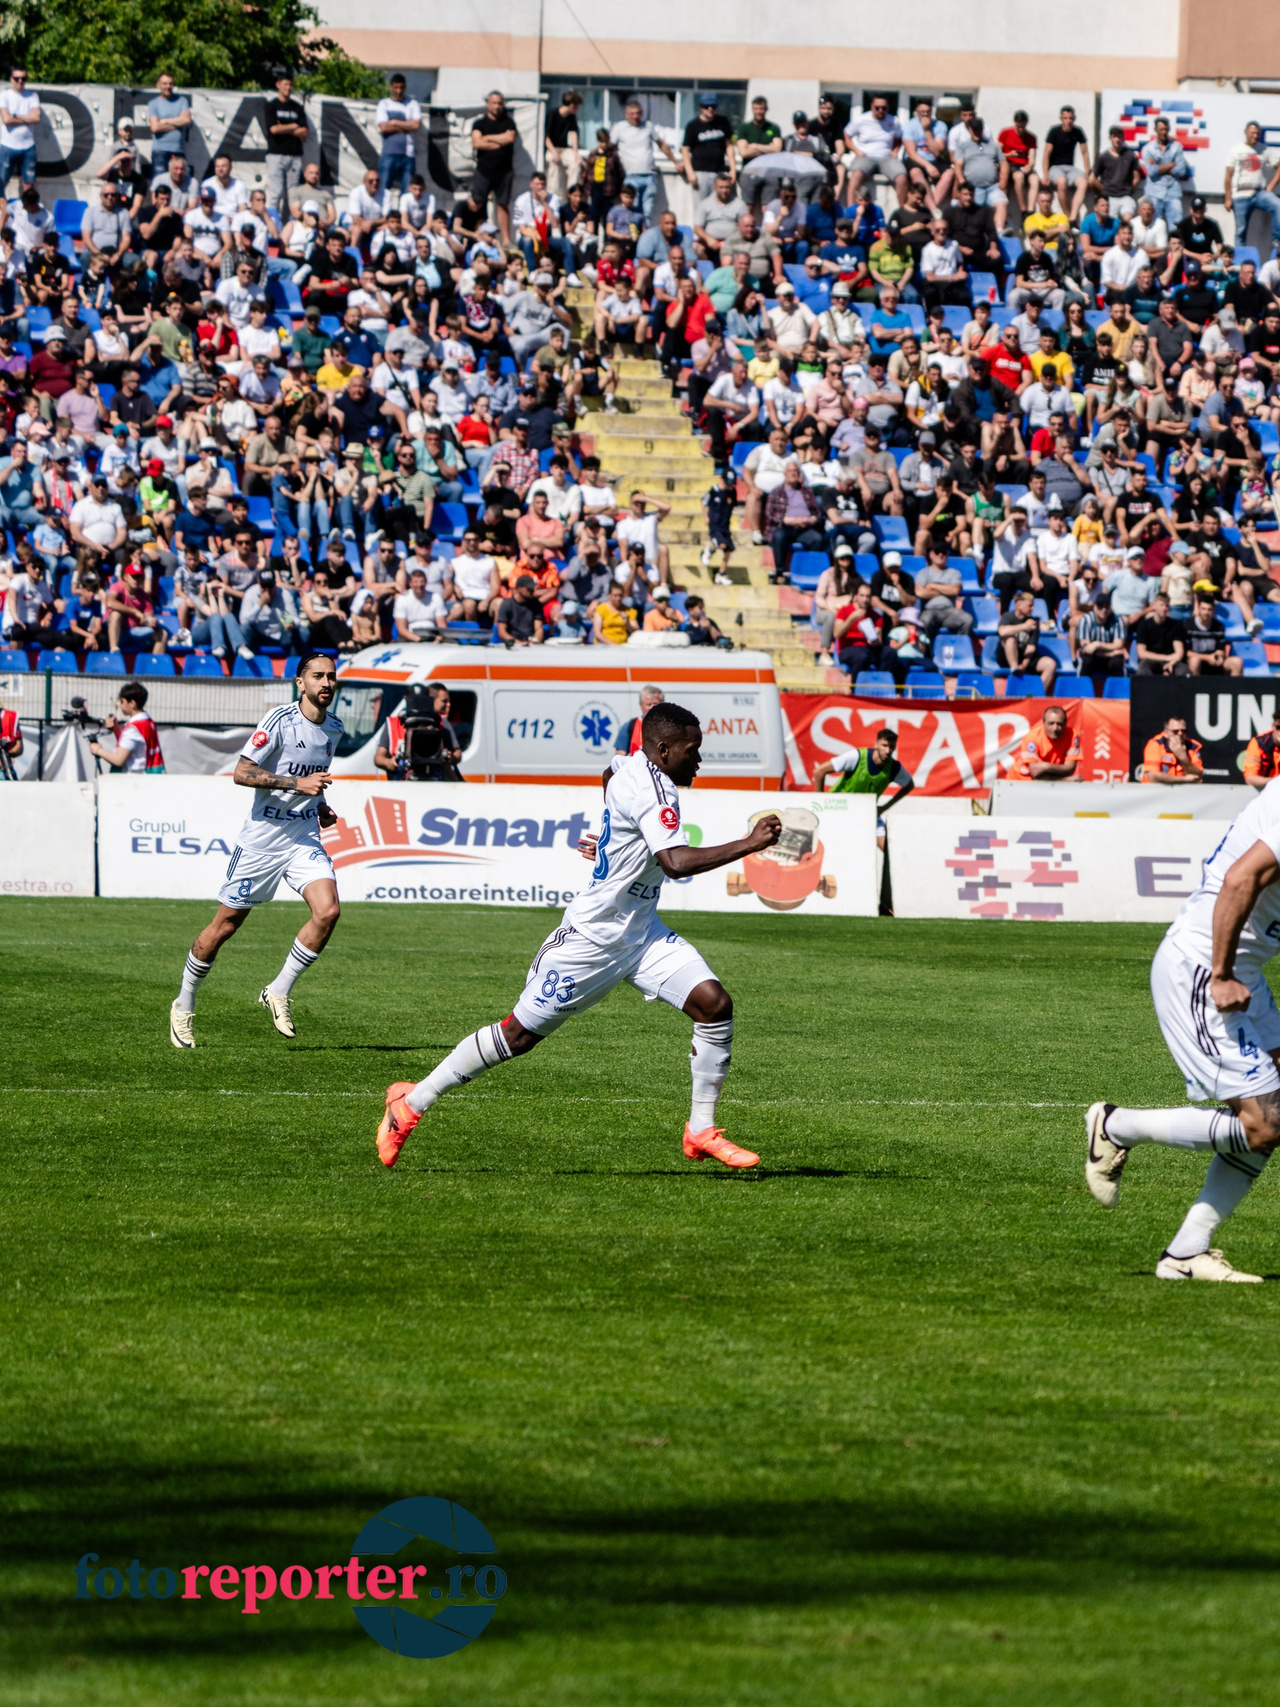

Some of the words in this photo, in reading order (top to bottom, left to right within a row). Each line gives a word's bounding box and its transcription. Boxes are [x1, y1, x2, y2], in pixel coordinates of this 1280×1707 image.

[643, 439, 655, 455] 9
[685, 515, 695, 528] 7
[515, 719, 555, 740] 112
[703, 718, 759, 736] ANTA
[262, 805, 319, 821] ELSAC
[129, 818, 187, 837] Grupul
[417, 807, 590, 849] Smart
[130, 836, 234, 857] ELSA
[0, 877, 74, 893] estra.ro
[238, 877, 252, 898] 8
[374, 882, 581, 907] contoareintelige
[541, 969, 576, 1004] 83
